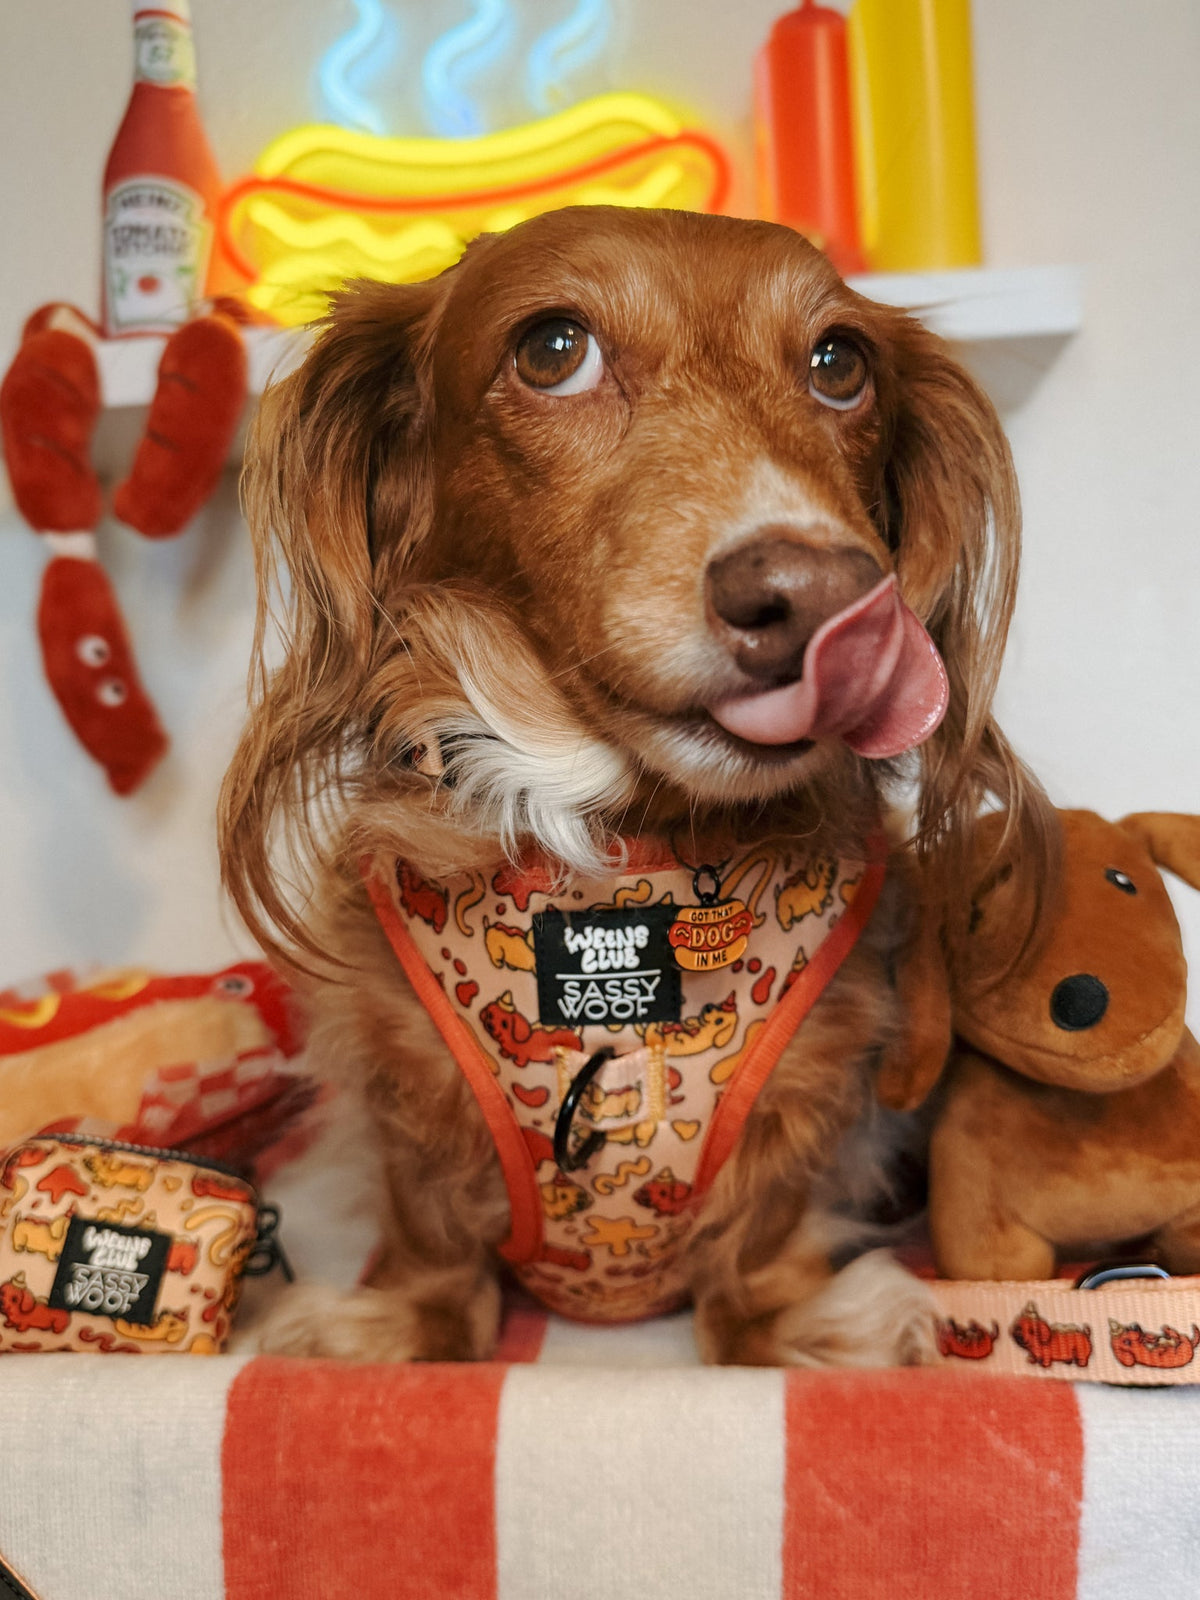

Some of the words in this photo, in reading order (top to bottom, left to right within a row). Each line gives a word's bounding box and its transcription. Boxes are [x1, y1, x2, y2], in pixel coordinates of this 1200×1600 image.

[121, 194, 182, 211] HEINZ
[691, 912, 708, 921] GOT
[712, 906, 733, 918] THAT
[564, 925, 650, 955] WEENS
[691, 922, 735, 949] DOG
[581, 947, 640, 973] CLUB
[696, 953, 708, 967] IN
[713, 951, 727, 962] ME
[563, 976, 661, 1003] SASSY
[557, 996, 656, 1020] WOOF
[72, 1268, 149, 1295] SASSY
[64, 1283, 140, 1314] WOOF
